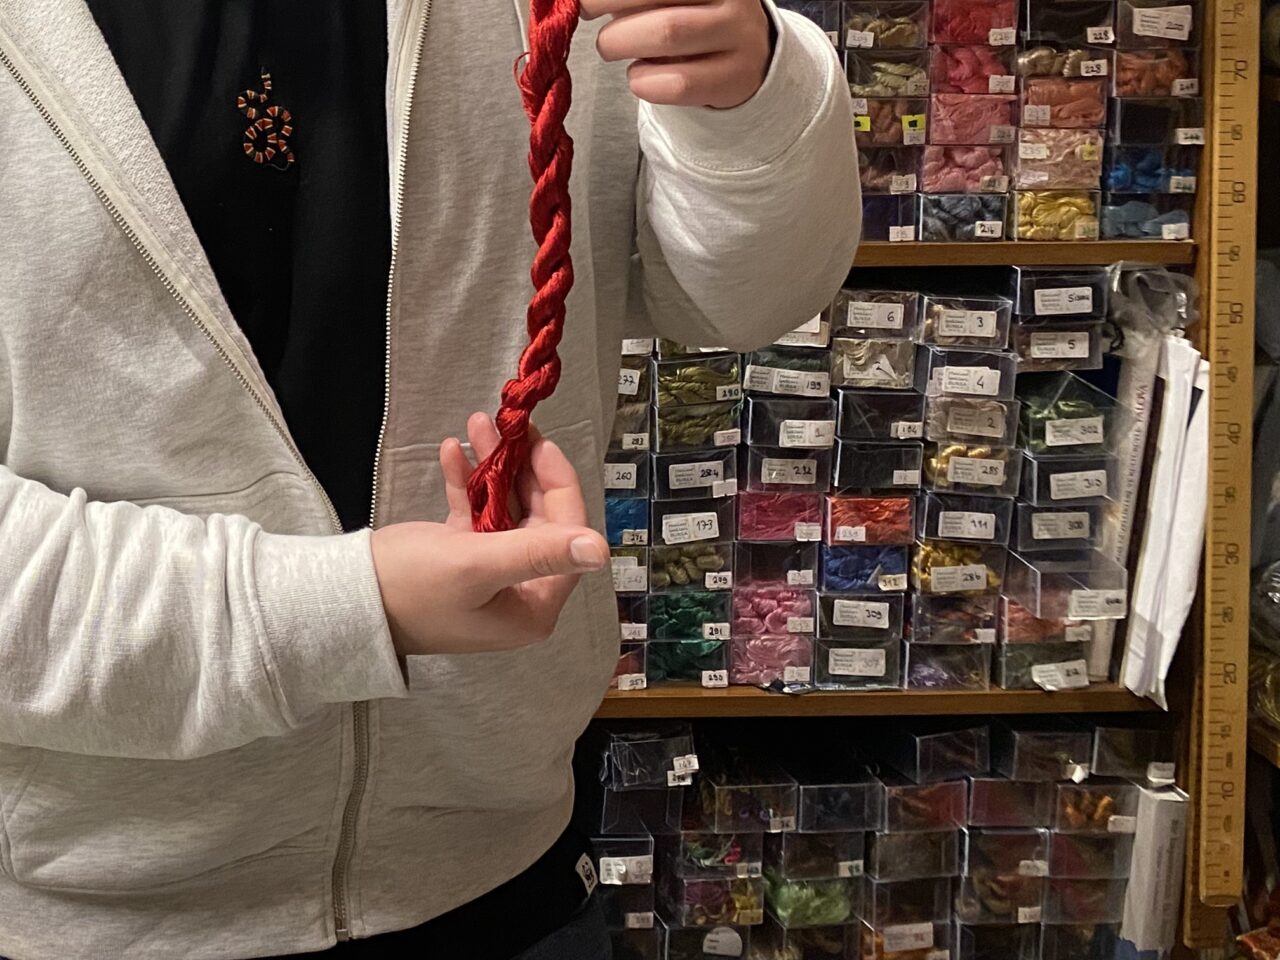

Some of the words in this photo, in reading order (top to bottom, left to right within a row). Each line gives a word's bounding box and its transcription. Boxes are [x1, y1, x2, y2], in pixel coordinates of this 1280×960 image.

[1233, 58, 1248, 80] 70
[1232, 181, 1246, 203] 60
[1228, 302, 1244, 324] 50
[1227, 422, 1242, 444] 40
[1224, 543, 1240, 565] 30
[1224, 662, 1237, 685] 20
[1222, 781, 1234, 800] 10
